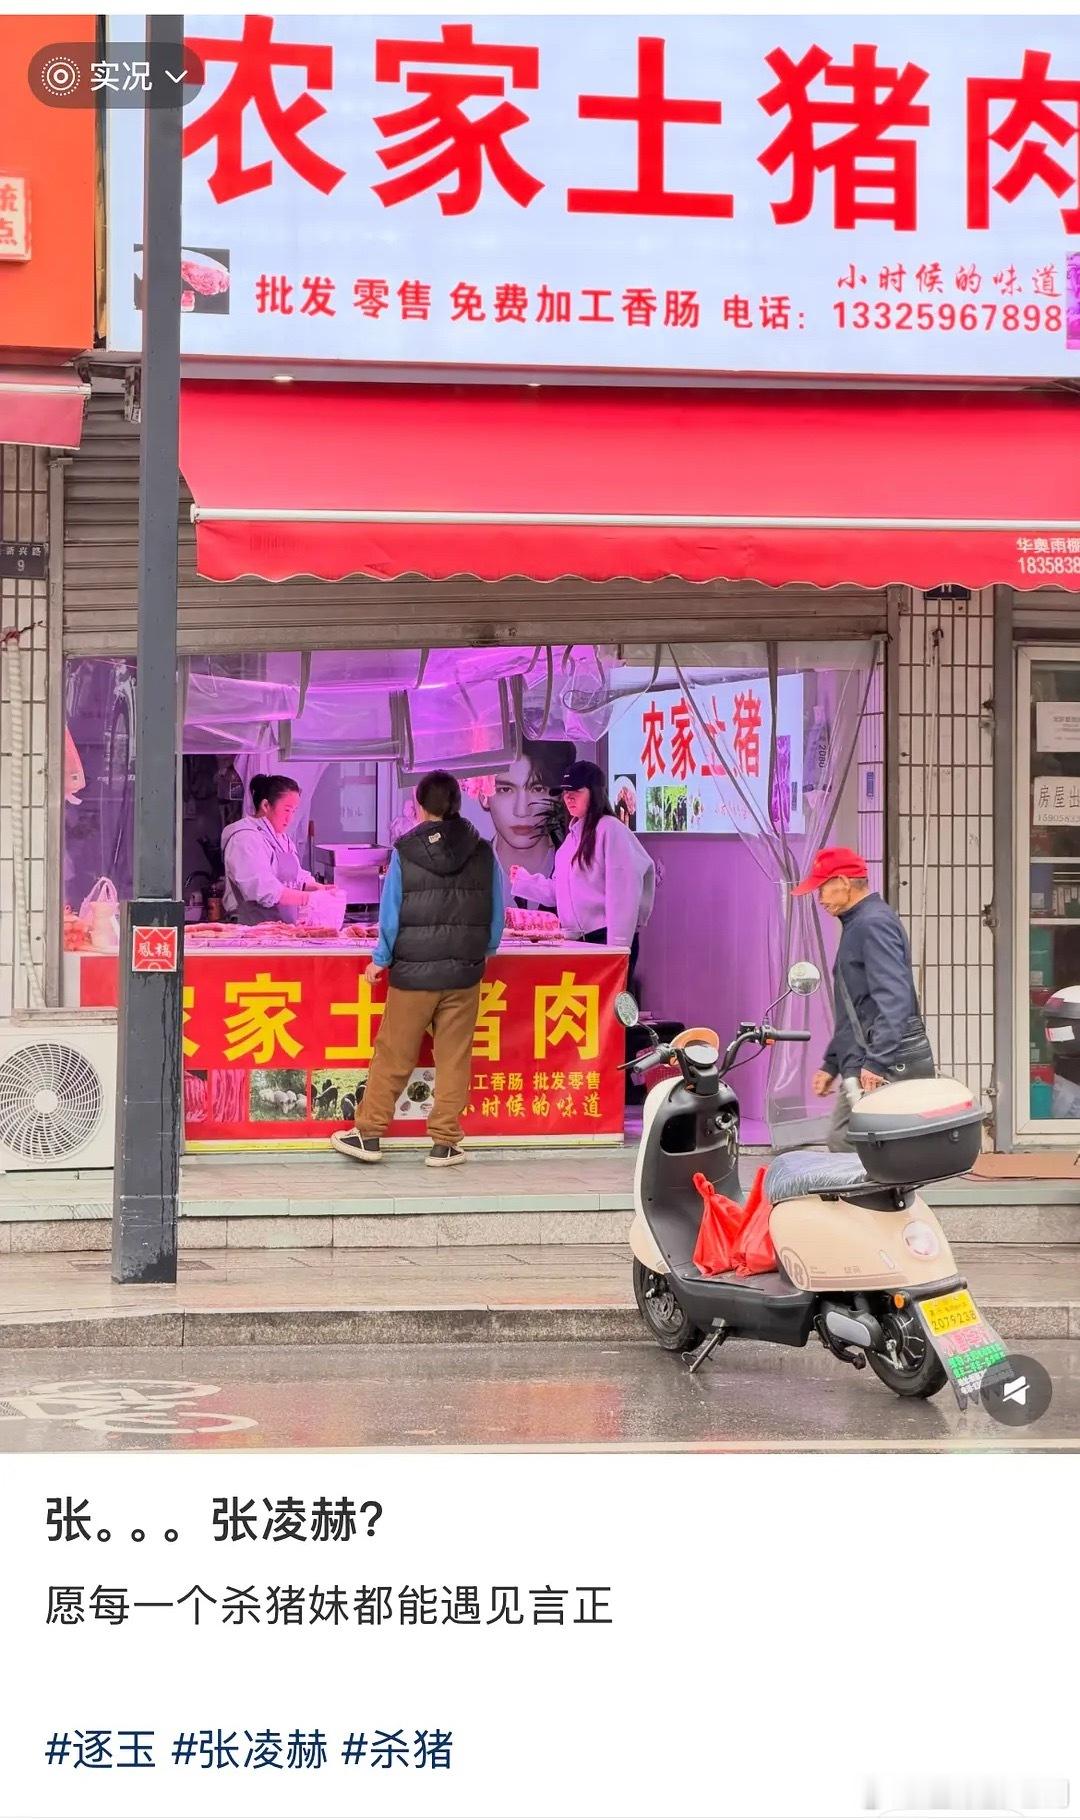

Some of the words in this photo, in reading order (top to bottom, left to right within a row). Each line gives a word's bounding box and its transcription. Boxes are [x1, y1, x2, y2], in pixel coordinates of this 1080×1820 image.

[183, 15, 1080, 236] 农家土猪肉
[837, 262, 1062, 298] 小时候的味道
[256, 275, 336, 317] 批发
[353, 278, 432, 321] 零售
[450, 282, 700, 329] 免费加工香肠
[833, 301, 1063, 332] 13325967898
[17, 559, 25, 571] 9
[640, 688, 762, 782] 农家土猪
[468, 1072, 523, 1091] 工香肠
[533, 1071, 600, 1091] 批发零售
